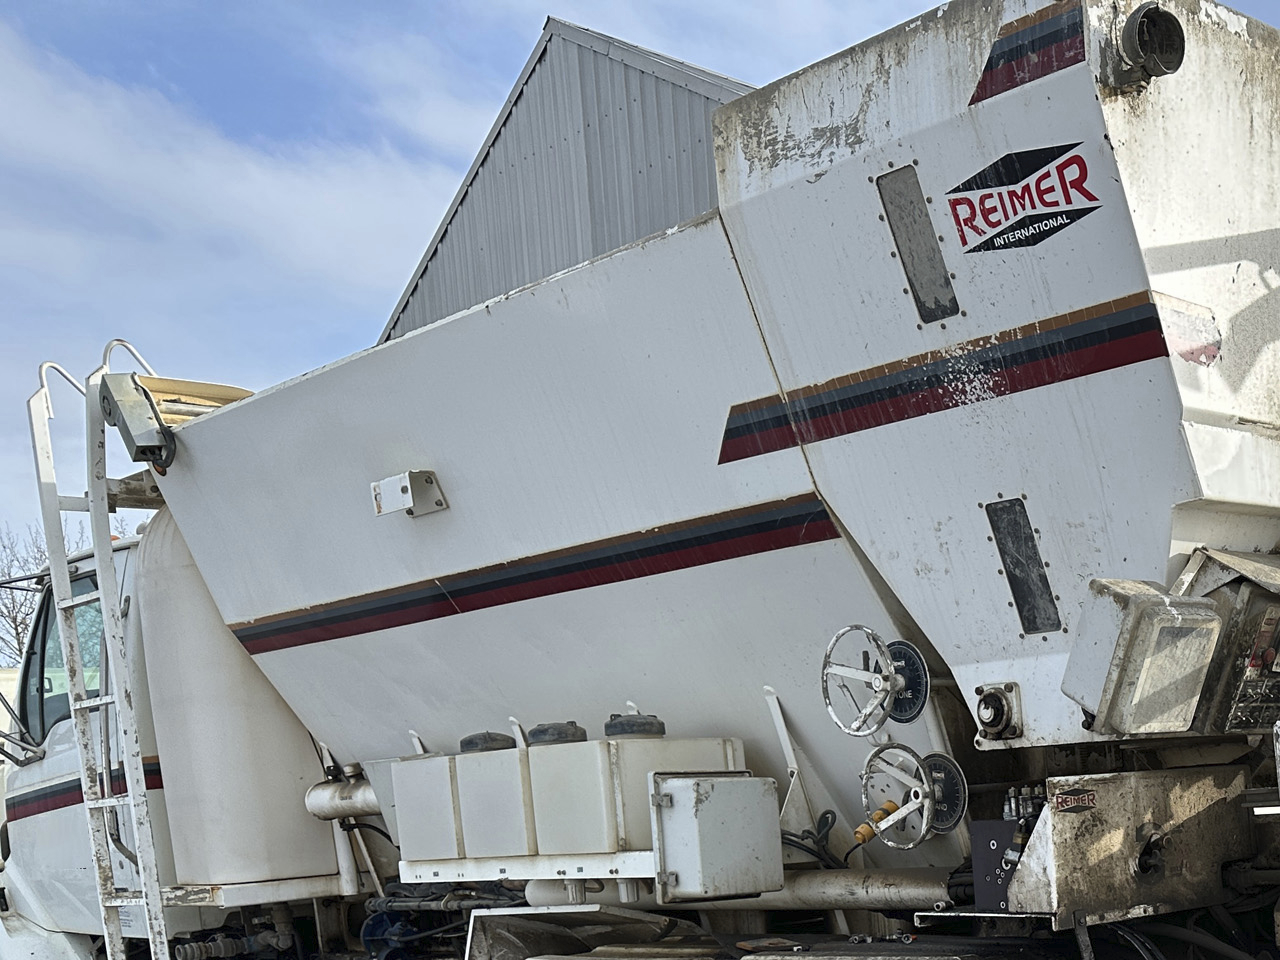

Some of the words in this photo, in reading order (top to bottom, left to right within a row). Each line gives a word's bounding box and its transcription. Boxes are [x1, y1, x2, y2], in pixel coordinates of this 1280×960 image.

[947, 154, 1100, 248] REIMER
[993, 213, 1070, 247] INTERNATIONAL
[1055, 793, 1097, 810] REIMER
